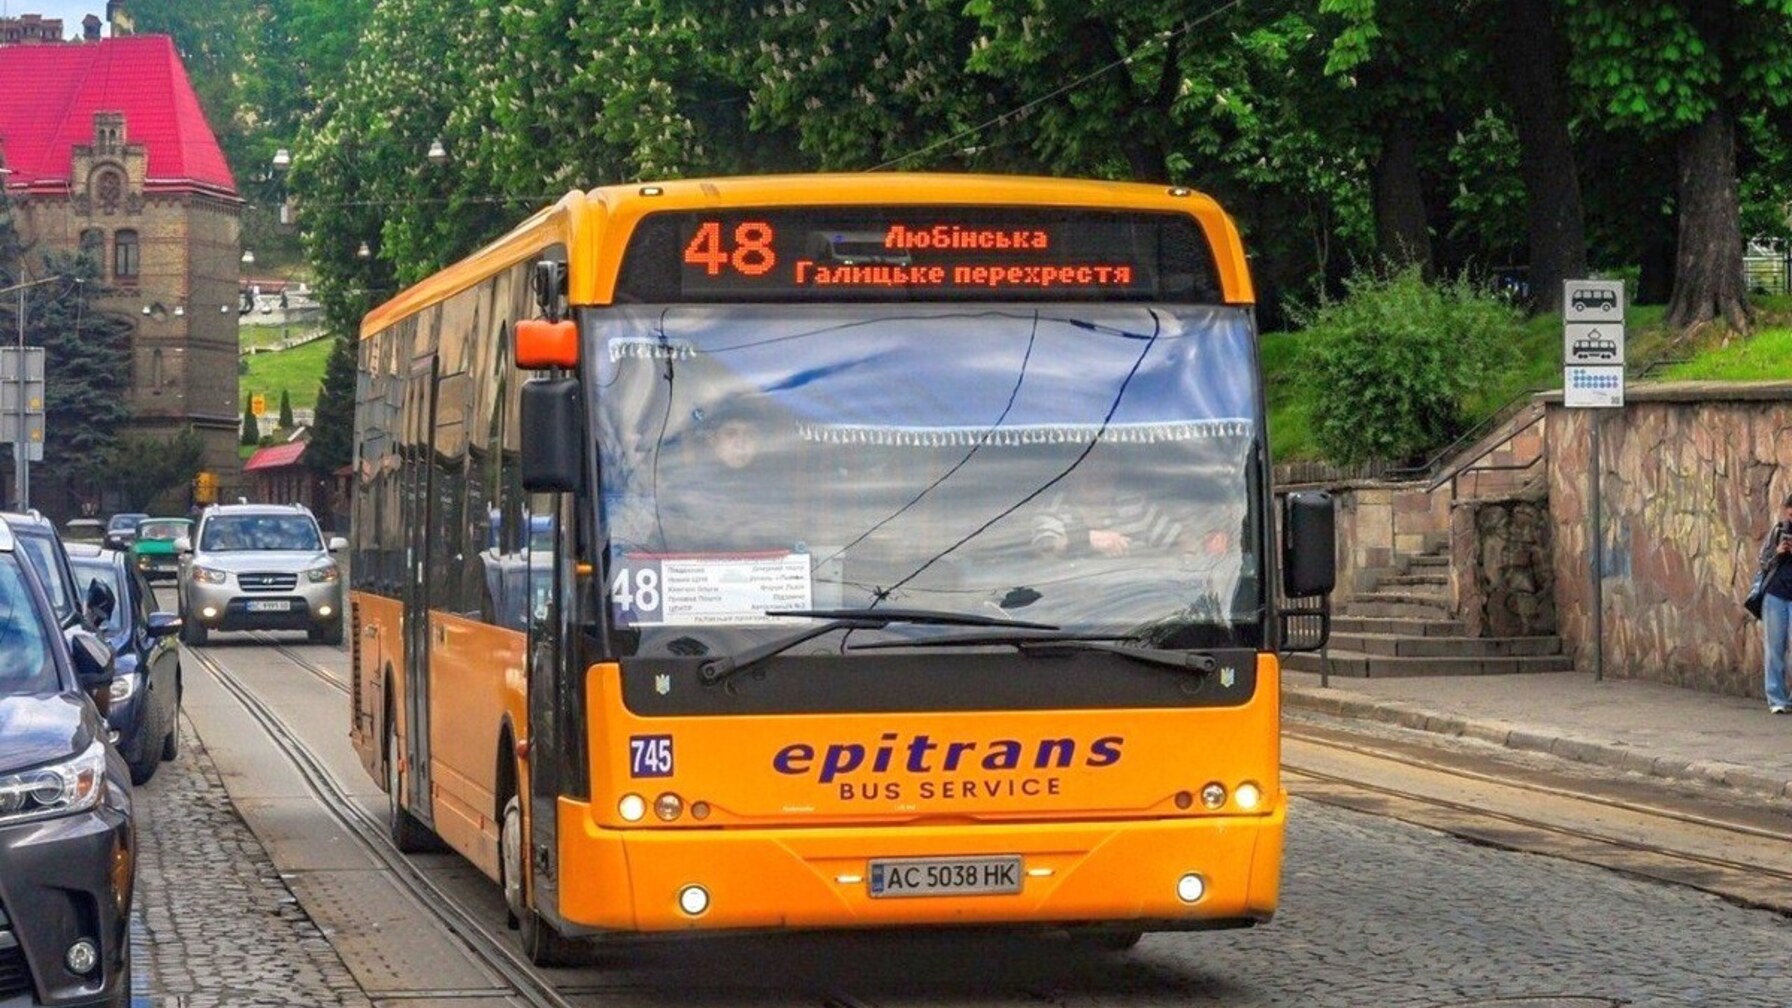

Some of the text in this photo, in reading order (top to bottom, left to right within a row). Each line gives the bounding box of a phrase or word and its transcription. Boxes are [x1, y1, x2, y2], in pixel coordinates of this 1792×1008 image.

[684, 222, 776, 275] 48
[884, 225, 1047, 249] Любінська
[796, 261, 1131, 287] Галицьке перехрестя
[612, 568, 660, 612] 48
[631, 738, 673, 774] 745
[772, 732, 1124, 784] epitrans
[839, 778, 1060, 801] BUS SERVICE
[887, 863, 1016, 889] AC 5038 HK
